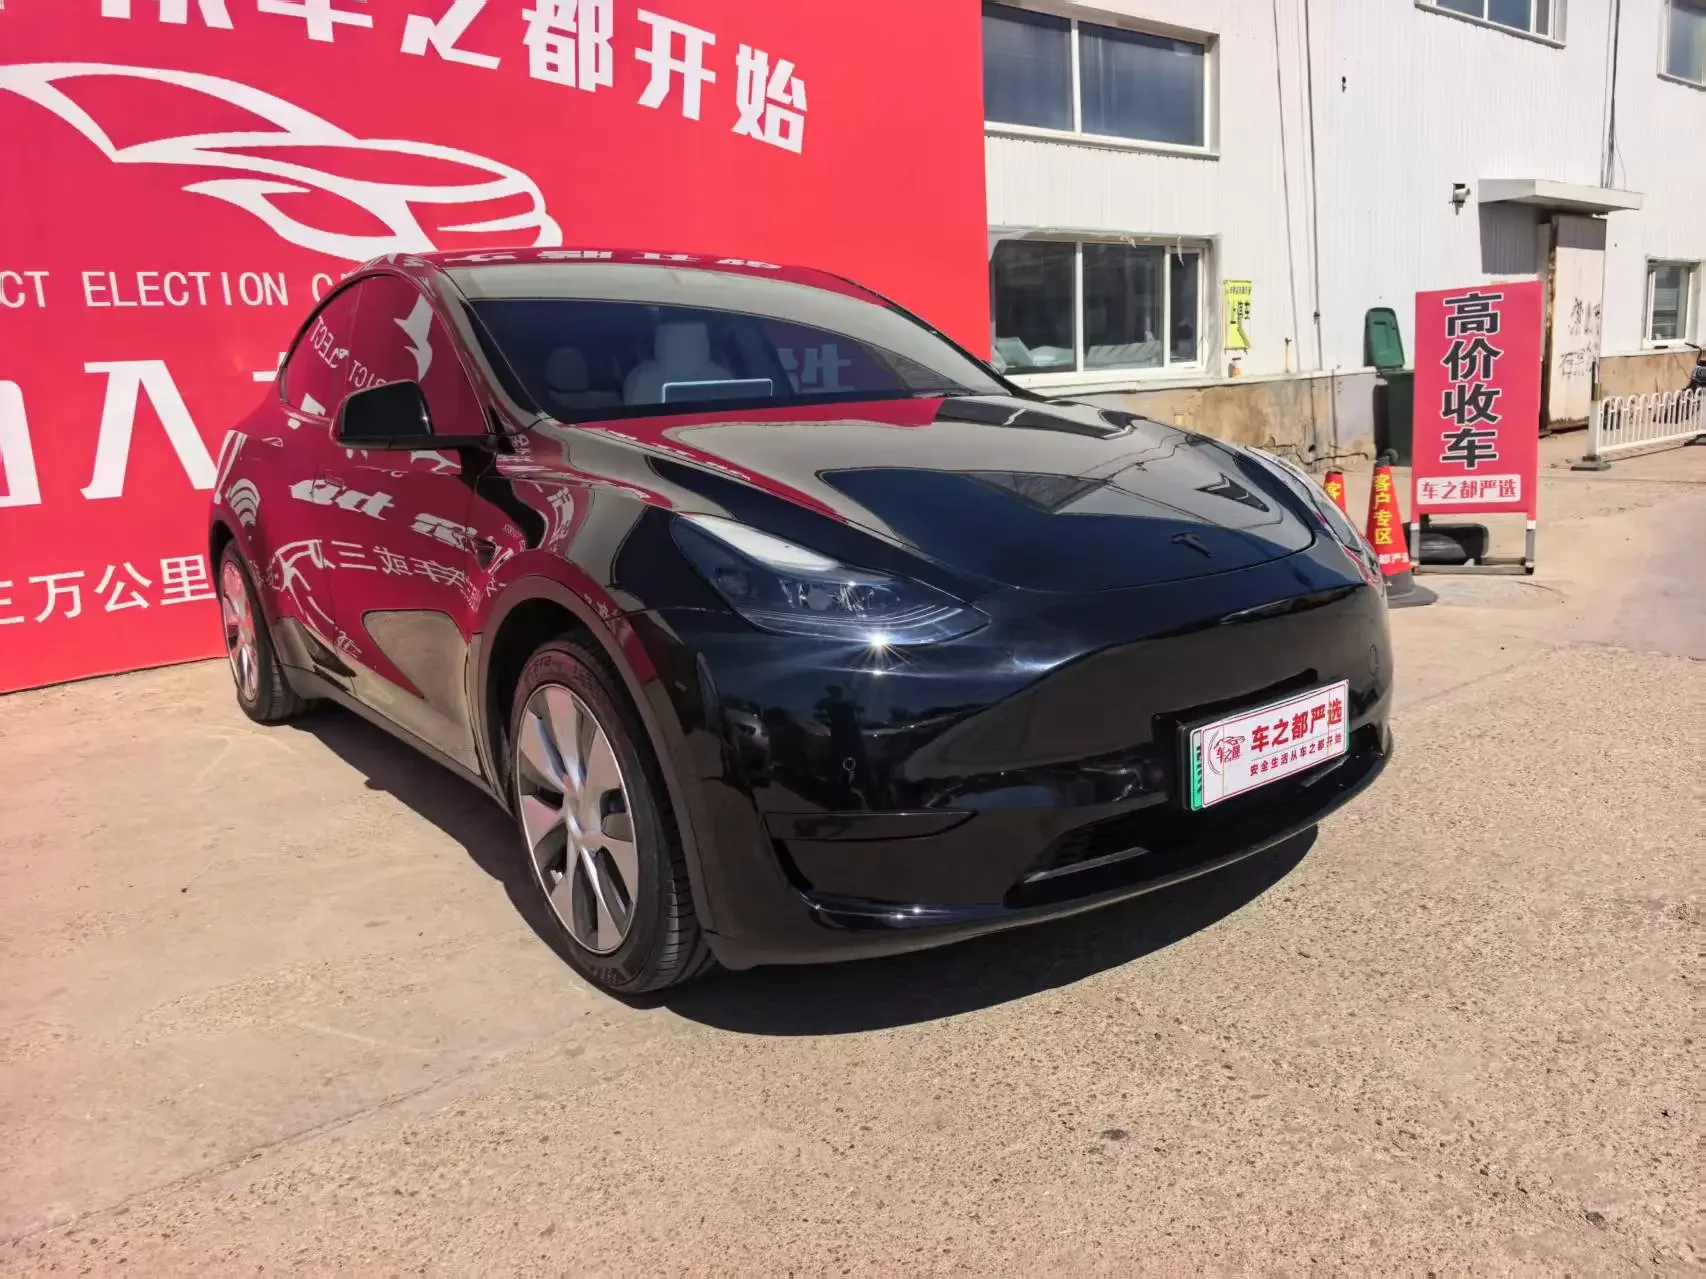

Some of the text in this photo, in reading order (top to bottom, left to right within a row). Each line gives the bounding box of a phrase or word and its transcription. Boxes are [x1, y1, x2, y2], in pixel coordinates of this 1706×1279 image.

[82, 271, 289, 307] ELECTION
[1440, 291, 1503, 470] 高价收车
[1373, 473, 1393, 545] 客户专区
[1421, 478, 1517, 500] 车之都严选
[1250, 697, 1342, 752] 车之都严选
[1249, 733, 1342, 776] 安全生活从车之都开始
